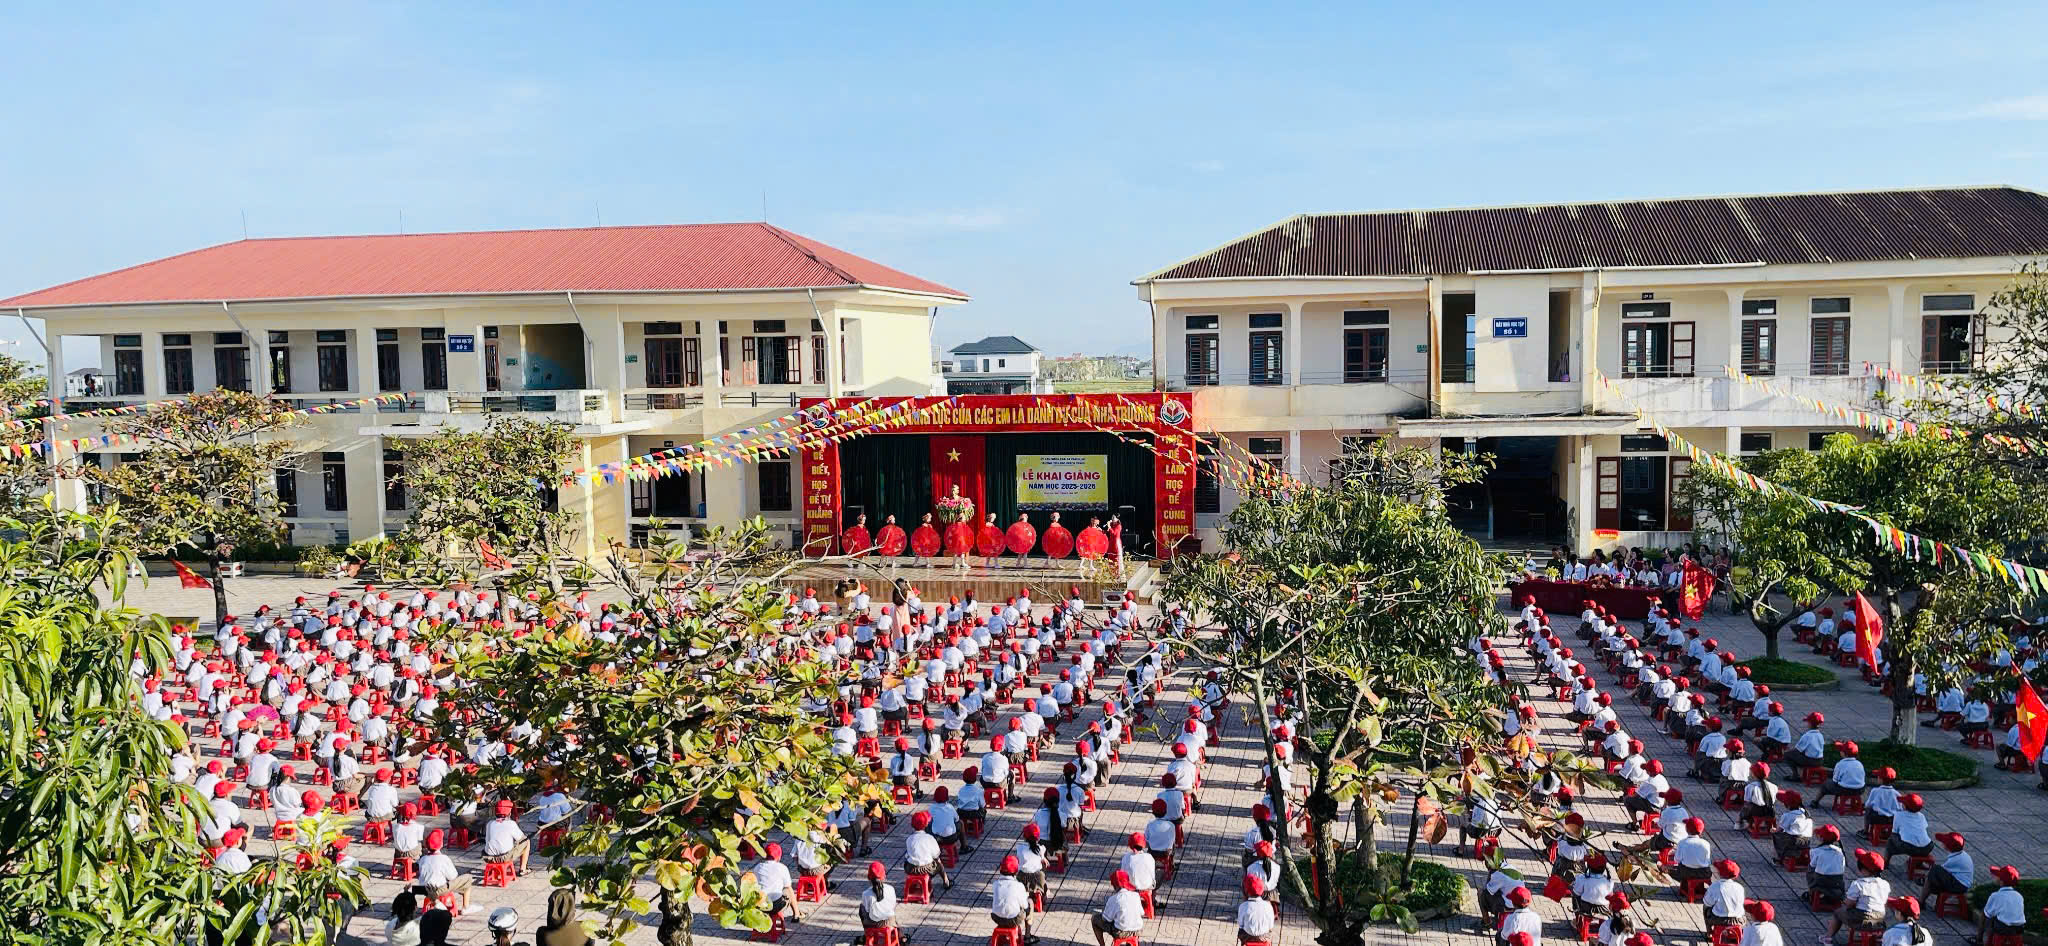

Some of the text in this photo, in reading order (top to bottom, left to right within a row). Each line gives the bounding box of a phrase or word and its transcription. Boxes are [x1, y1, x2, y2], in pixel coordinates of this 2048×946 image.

[953, 403, 972, 425] CỦA
[974, 405, 994, 424] CÁC
[995, 407, 1010, 424] EM
[1013, 404, 1025, 424] LÀ
[1027, 406, 1054, 424] DANH
[1022, 469, 1101, 481] LỄ KHAI GIẢNG
[811, 480, 828, 492] HỌC
[1165, 480, 1184, 491] HỌC
[1161, 524, 1189, 535] CHUNG
